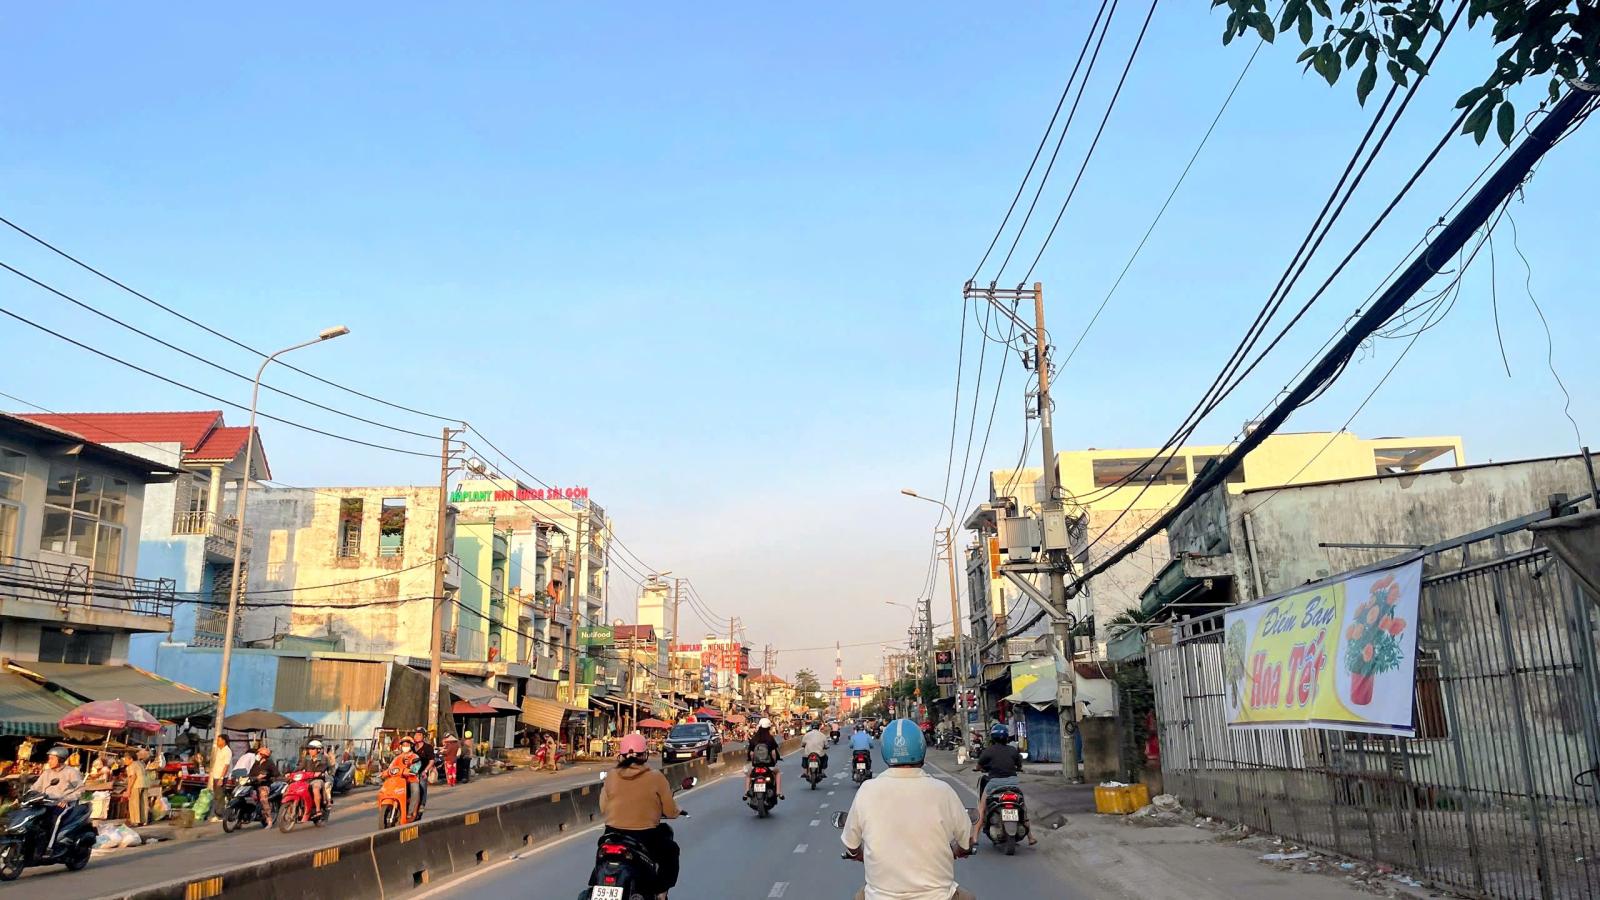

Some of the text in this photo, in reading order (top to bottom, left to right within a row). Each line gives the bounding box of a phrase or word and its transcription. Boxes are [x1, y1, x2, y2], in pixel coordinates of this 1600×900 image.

[1301, 596, 1336, 629] Bán
[581, 630, 611, 639] Nutifood
[1250, 628, 1327, 710] Hoa Tết
[596, 887, 619, 898] 59-N3
